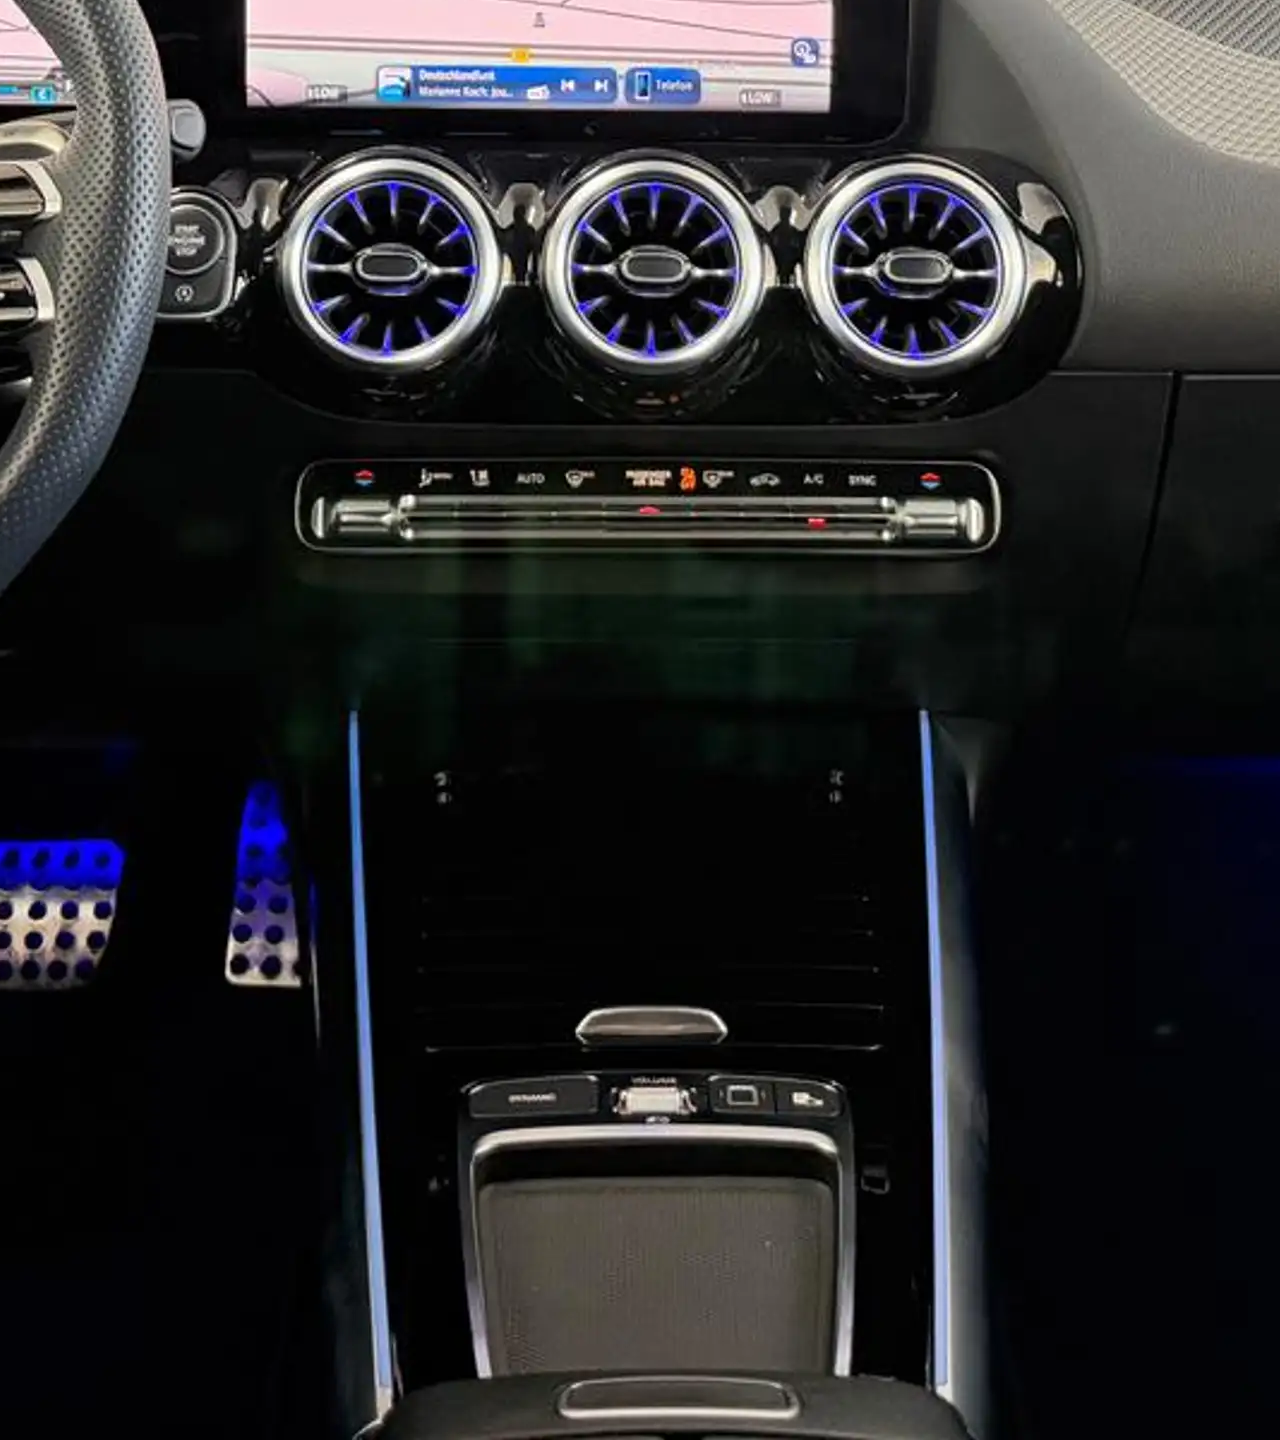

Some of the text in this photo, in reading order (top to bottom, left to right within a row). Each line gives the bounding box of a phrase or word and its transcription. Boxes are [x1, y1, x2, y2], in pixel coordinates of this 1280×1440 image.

[655, 79, 693, 92] Telefon
[516, 472, 545, 485] AUTO
[803, 474, 825, 486] A/C
[848, 475, 877, 487] SYNC
